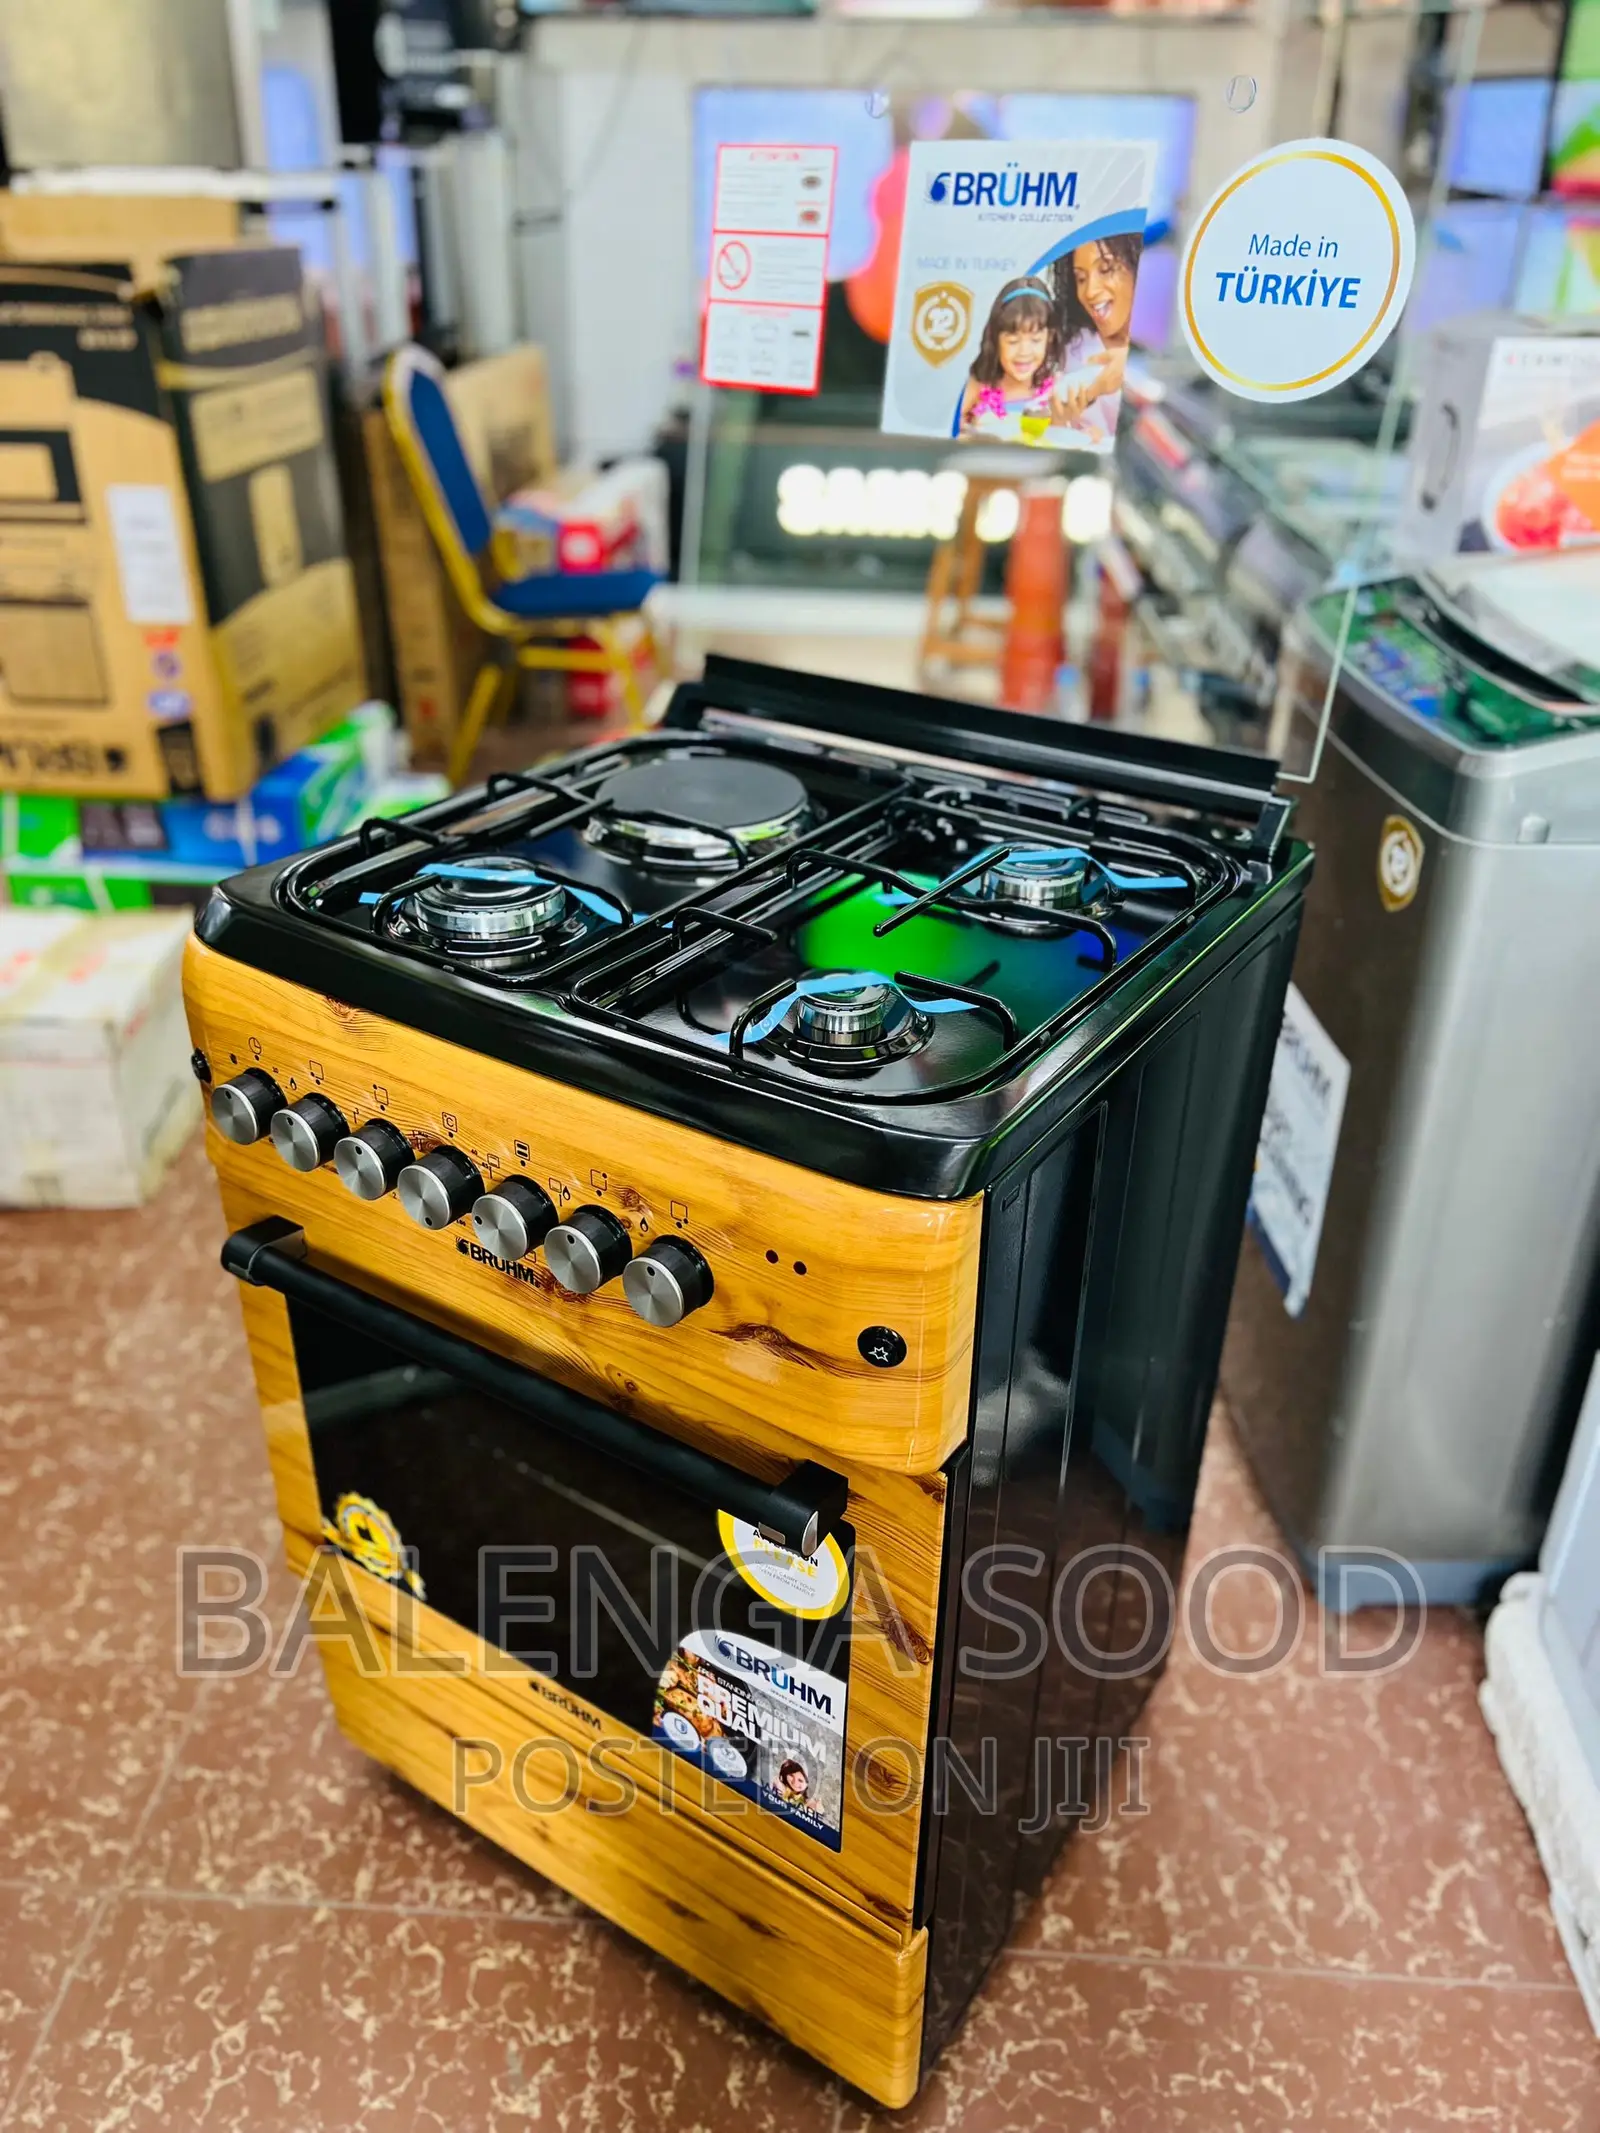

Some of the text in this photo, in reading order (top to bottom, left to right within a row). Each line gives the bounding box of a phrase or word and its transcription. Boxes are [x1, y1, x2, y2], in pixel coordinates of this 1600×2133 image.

[952, 161, 1079, 207] BRÜHM
[977, 212, 1074, 223] KITCHEN COLLECTION
[916, 256, 1017, 272] MADE IN TURKEY
[1248, 233, 1339, 259] Made in
[1215, 265, 1361, 309] TÜRKİYE
[735, 1646, 832, 1716] BRÜHM
[697, 1672, 827, 1763] PREMIUM
[762, 1790, 825, 1831] YOUR FAMILY
